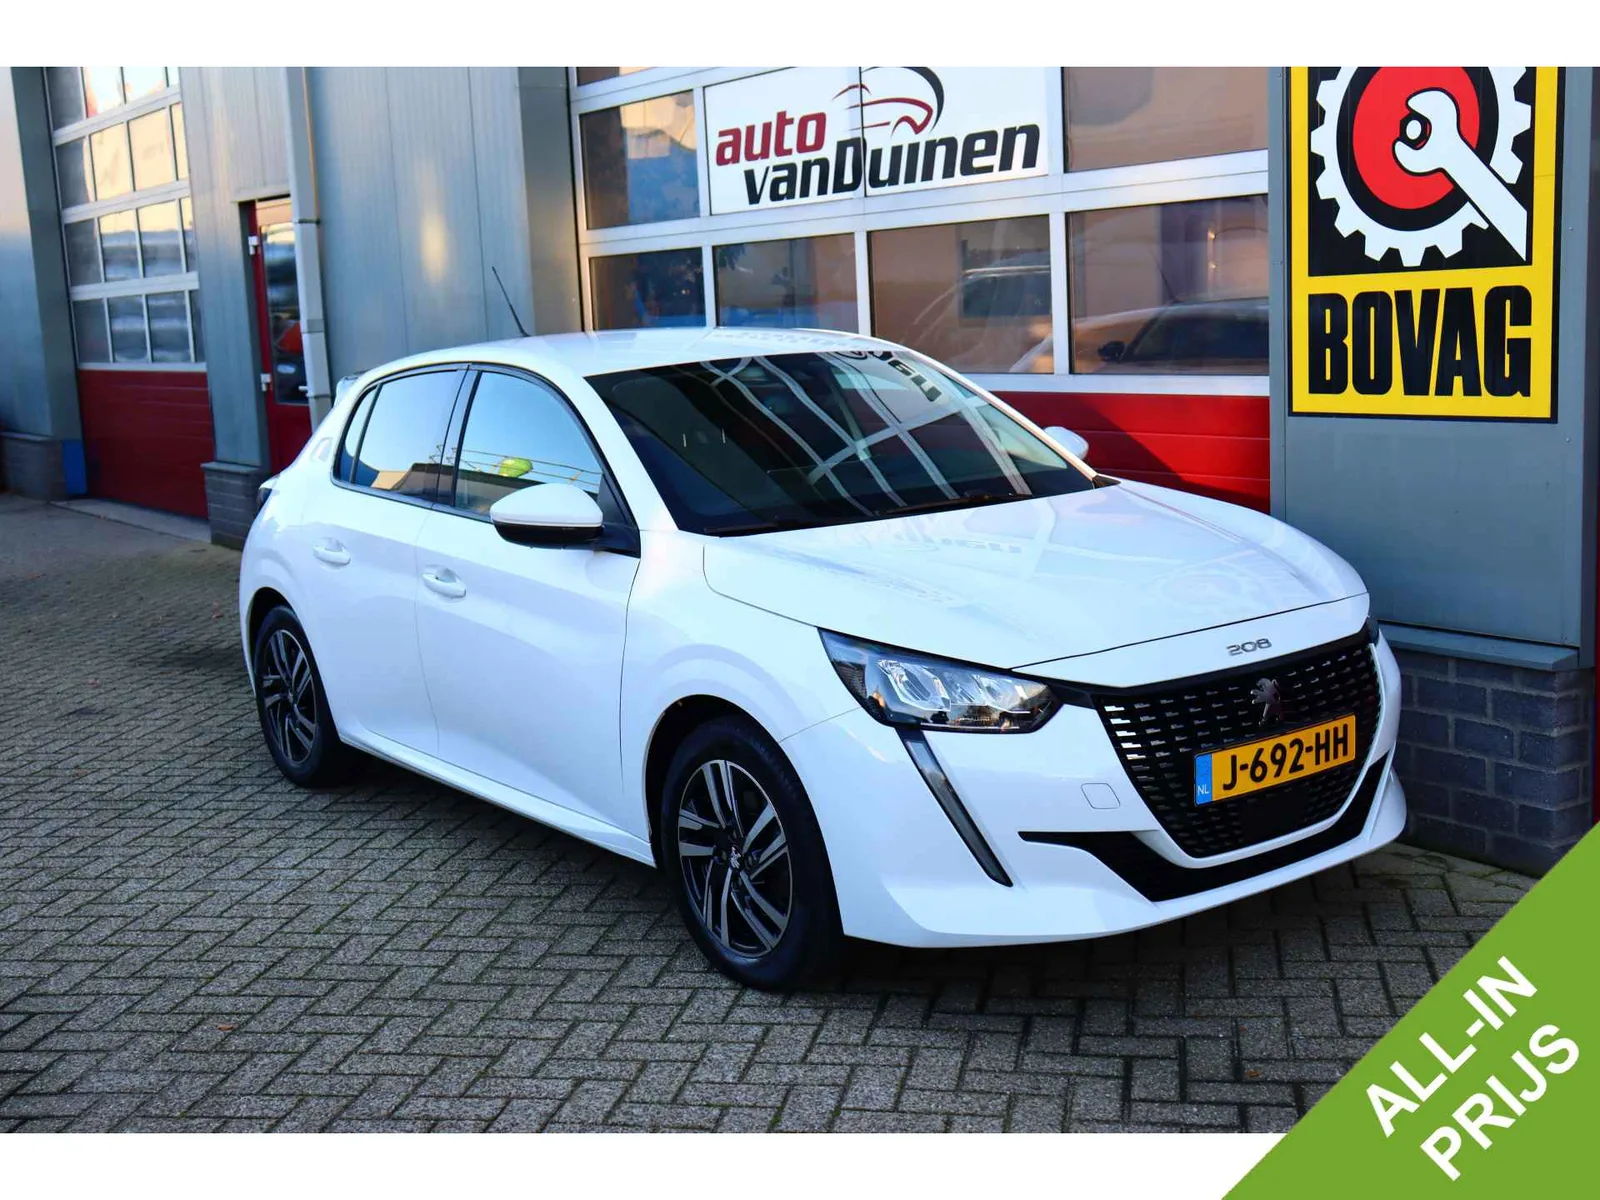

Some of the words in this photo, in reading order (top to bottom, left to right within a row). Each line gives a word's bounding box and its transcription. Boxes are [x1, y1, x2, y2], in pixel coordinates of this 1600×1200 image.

[715, 110, 827, 167] auto
[1307, 284, 1533, 399] BOVAG
[1226, 637, 1272, 657] 208
[1222, 723, 1349, 791] J-692-HH
[1196, 785, 1210, 795] NL
